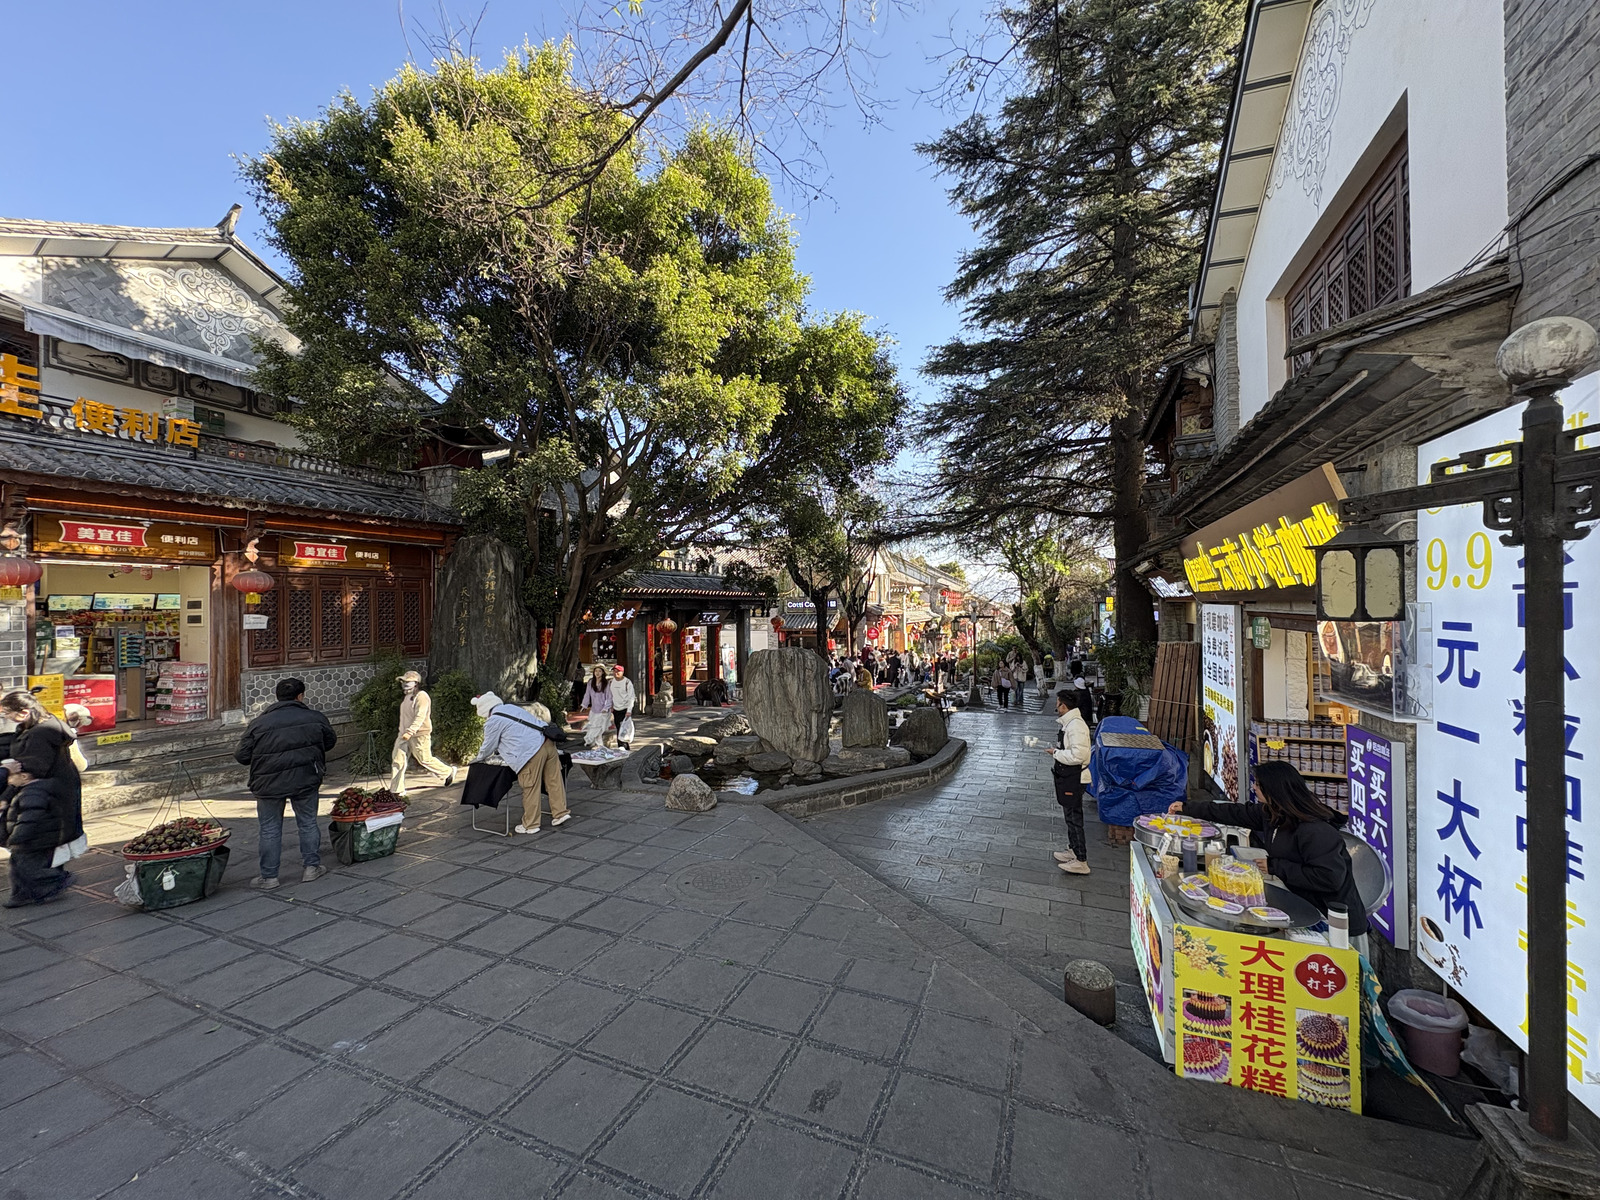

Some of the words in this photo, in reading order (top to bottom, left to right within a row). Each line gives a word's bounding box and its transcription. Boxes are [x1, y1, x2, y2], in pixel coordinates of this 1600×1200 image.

[71, 397, 201, 448] 便利店
[77, 527, 133, 543] 美宜佳
[160, 534, 199, 545] 便利店
[304, 546, 338, 558] 美宜佳
[355, 551, 379, 559] 便利店
[1307, 961, 1337, 975] 网红
[1307, 976, 1337, 993] 打卡
[1239, 940, 1288, 1099] 大理桂花糕
